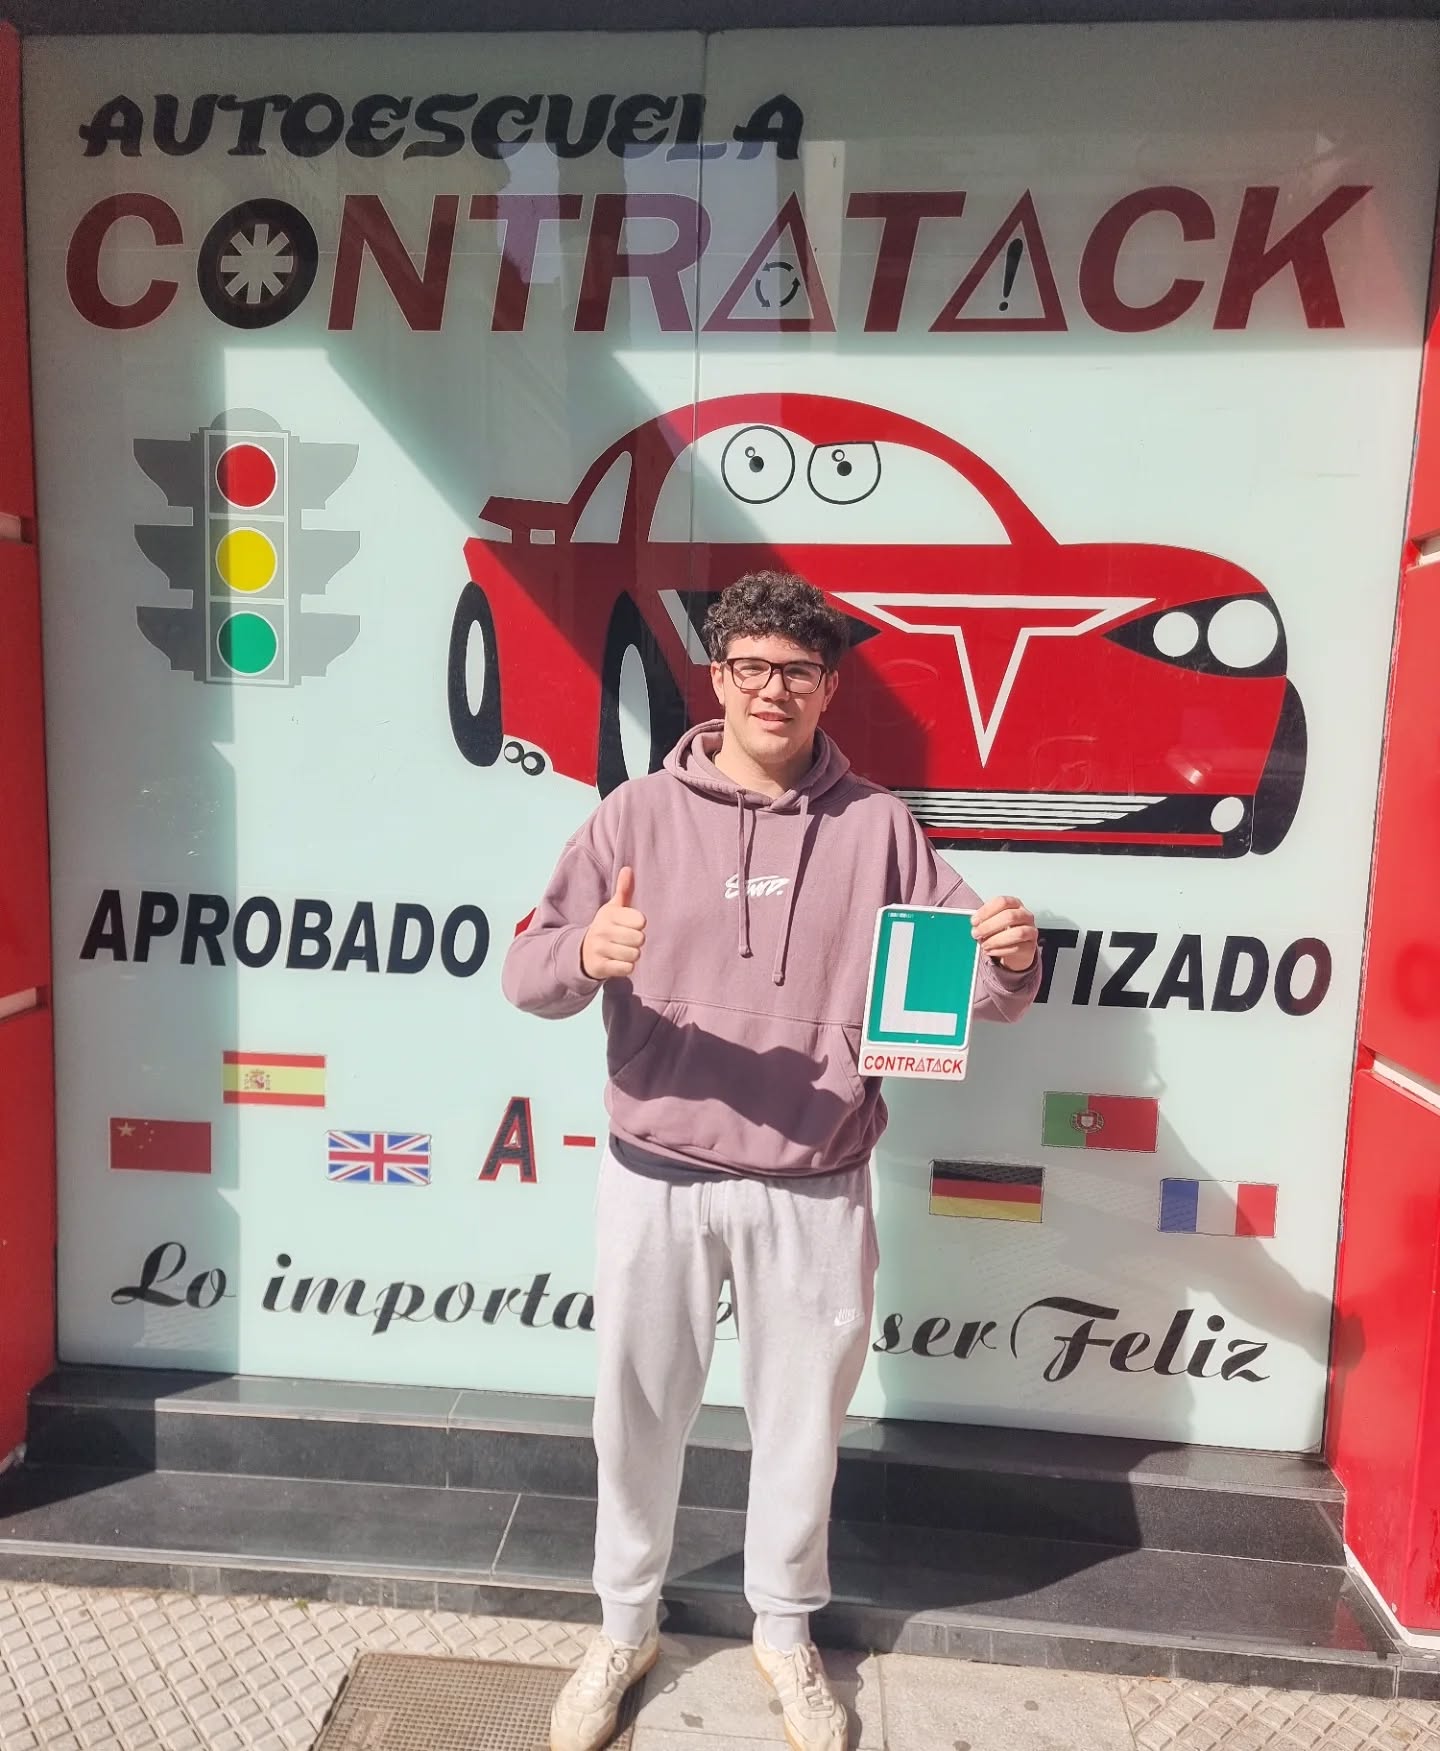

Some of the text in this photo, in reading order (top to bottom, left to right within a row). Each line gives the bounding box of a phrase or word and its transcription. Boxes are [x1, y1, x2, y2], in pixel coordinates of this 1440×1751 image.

[79, 93, 804, 161] AUTOESCUELA
[79, 889, 1333, 1017] APROBADO TIZADO
[879, 921, 958, 1036] L
[478, 1096, 538, 1184] A
[110, 1242, 1270, 1382] Lo importa ser Feliz
